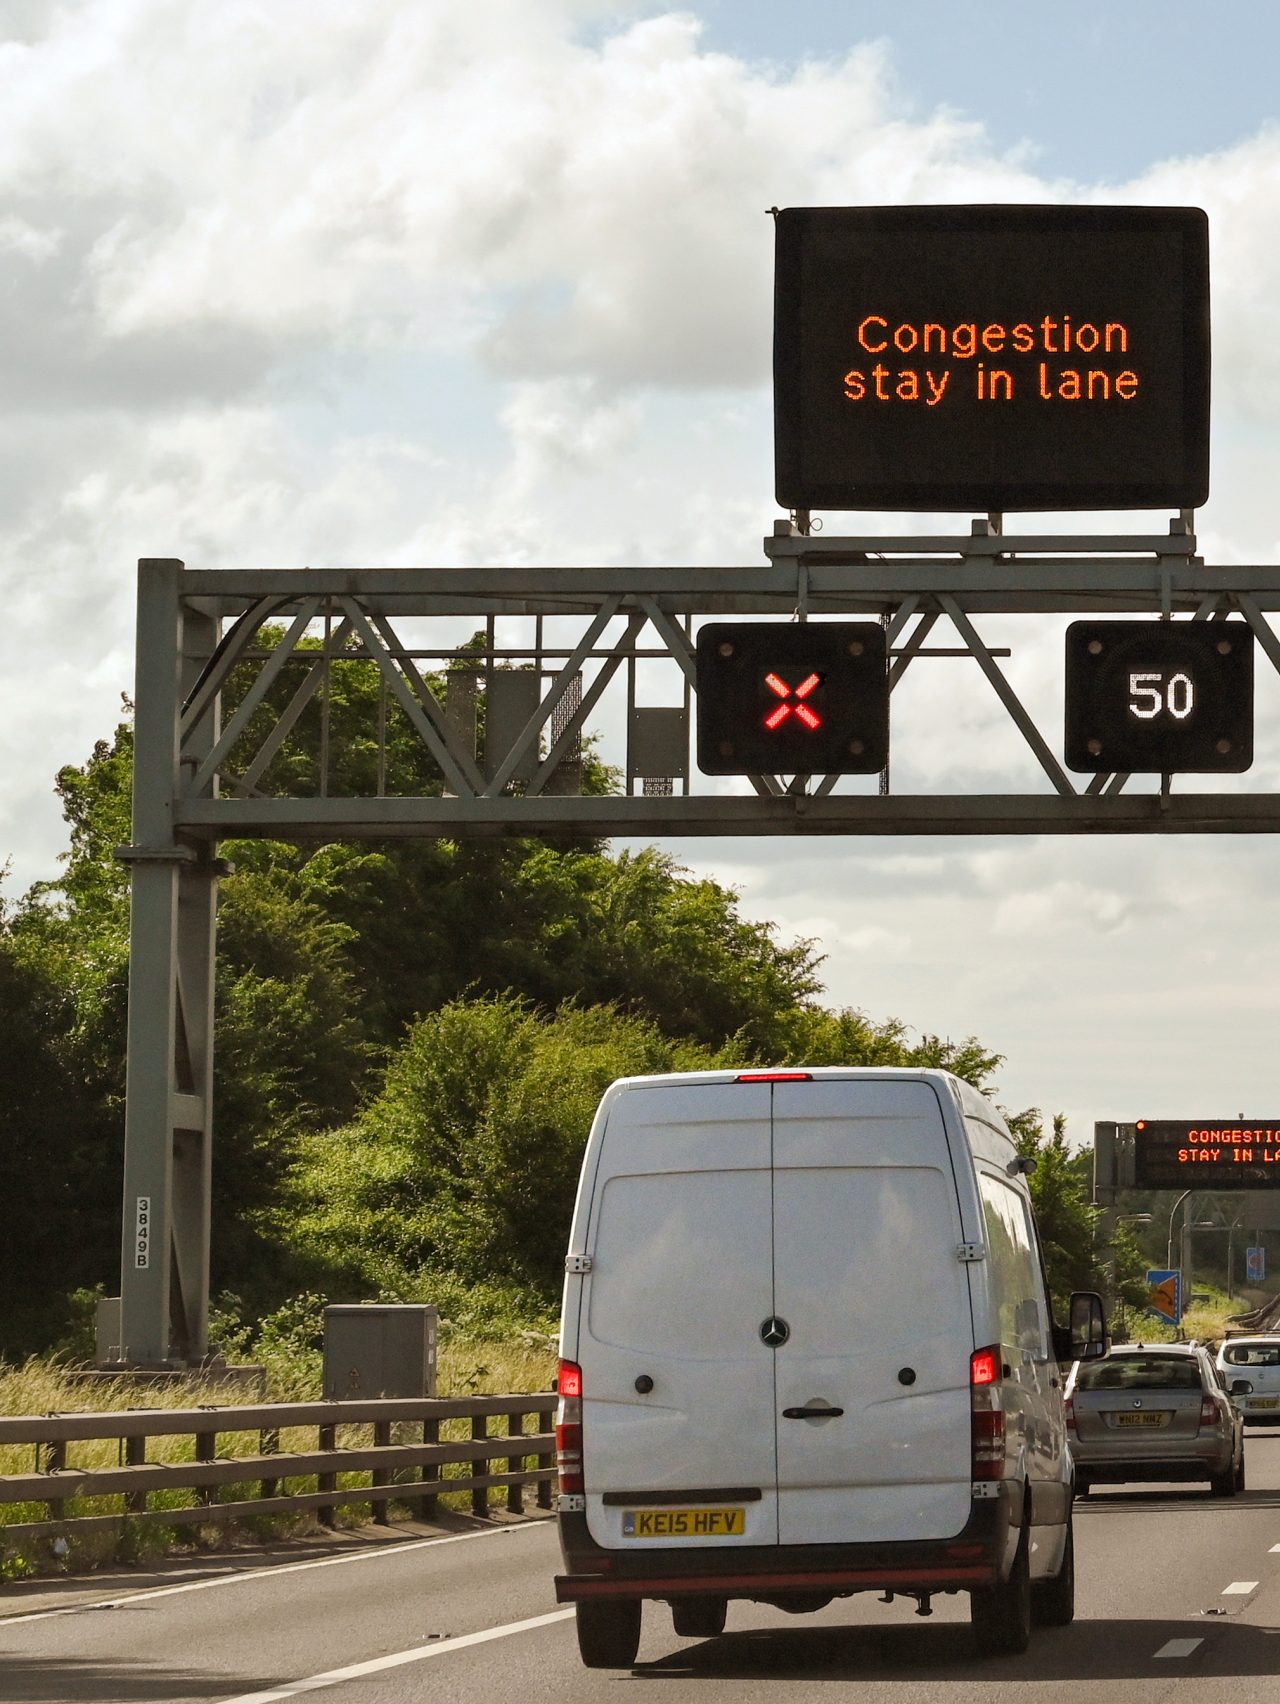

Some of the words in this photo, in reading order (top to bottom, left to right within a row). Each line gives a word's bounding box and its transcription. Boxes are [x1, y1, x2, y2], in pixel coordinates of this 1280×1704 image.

[858, 316, 1128, 359] Congestion
[844, 364, 950, 406] stay
[978, 363, 1012, 400] in
[1041, 363, 1139, 400] lane
[1129, 672, 1194, 718] 50
[1178, 1149, 1220, 1162] STAY
[1233, 1149, 1252, 1161] IN
[137, 1199, 148, 1267] 3849B
[639, 1512, 688, 1534] KE15
[694, 1511, 737, 1533] HFV
